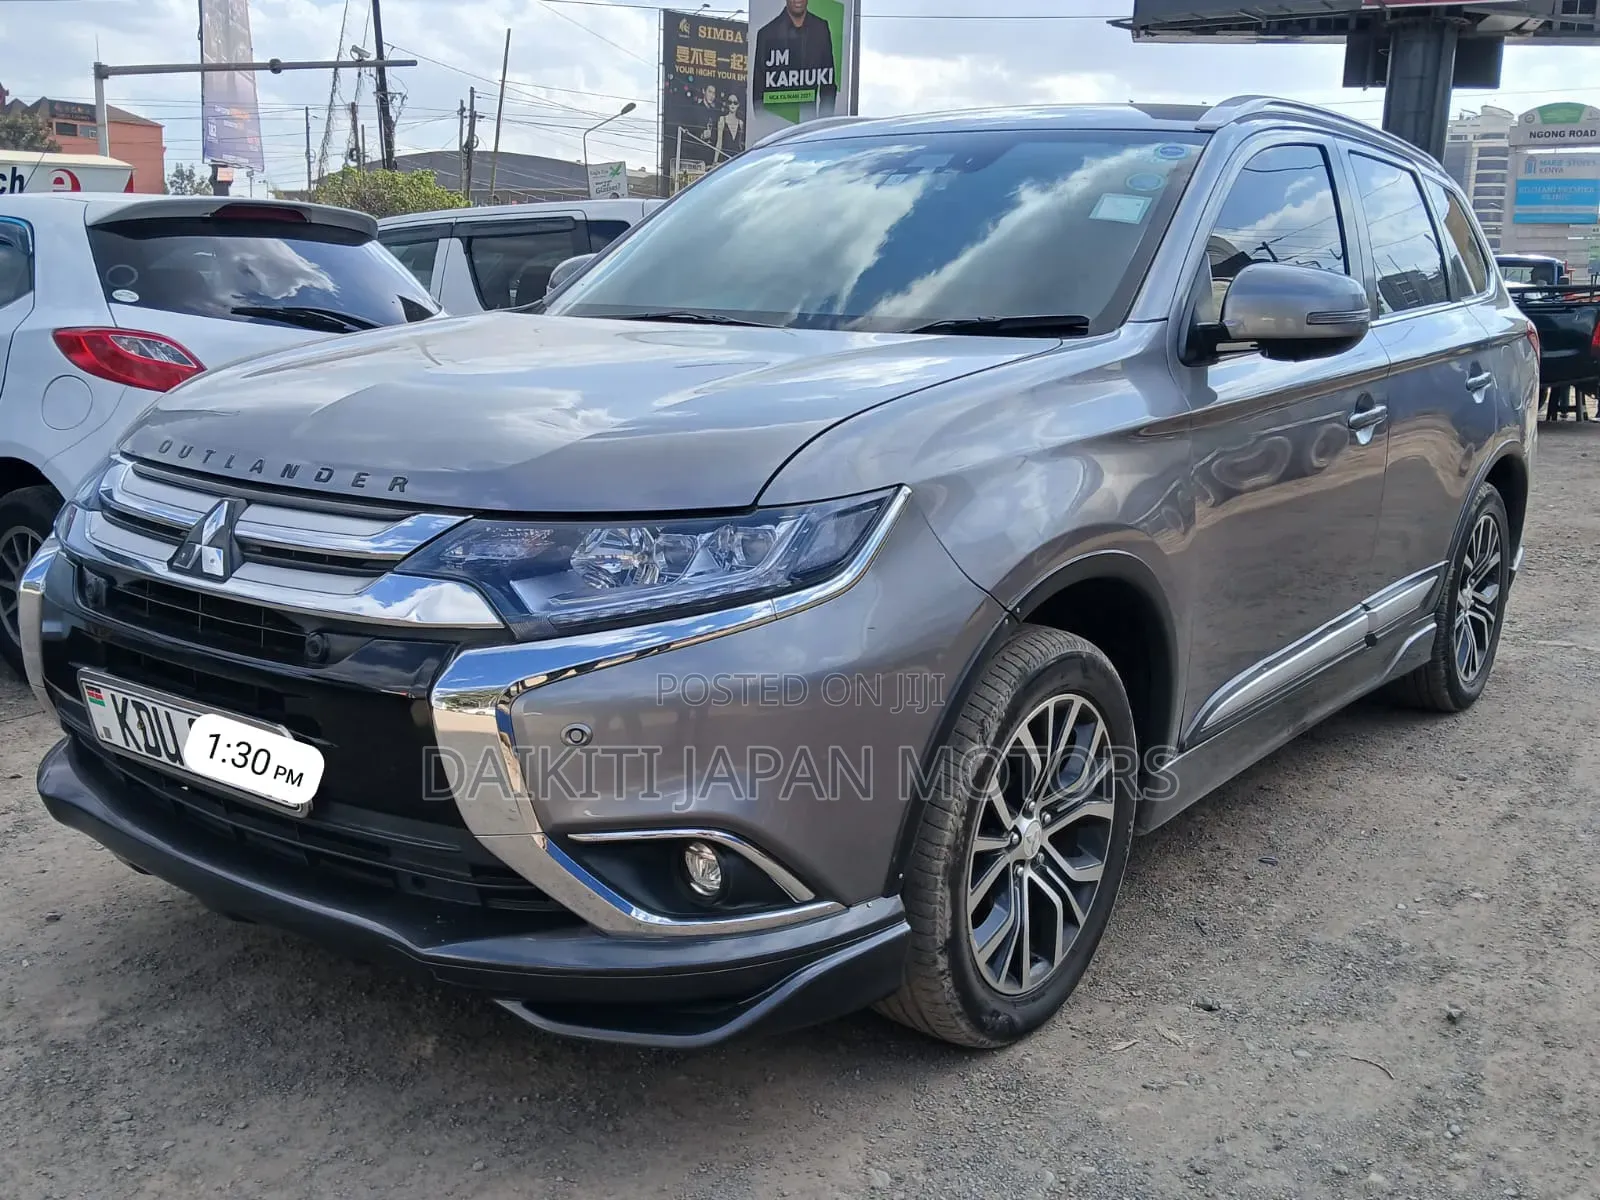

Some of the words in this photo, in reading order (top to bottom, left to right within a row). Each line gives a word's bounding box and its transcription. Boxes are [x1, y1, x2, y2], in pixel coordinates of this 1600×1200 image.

[698, 25, 743, 43] SIMBA
[765, 49, 790, 67] JM
[675, 64, 695, 75] YOUR
[695, 68, 716, 78] NIGHT
[717, 71, 736, 80] YOUR
[765, 67, 834, 88] KARIUKI
[1529, 130, 1566, 139] NGONG
[1569, 129, 1597, 138] ROAD
[158, 439, 409, 493] OUTLANDER
[110, 693, 184, 766] KDU
